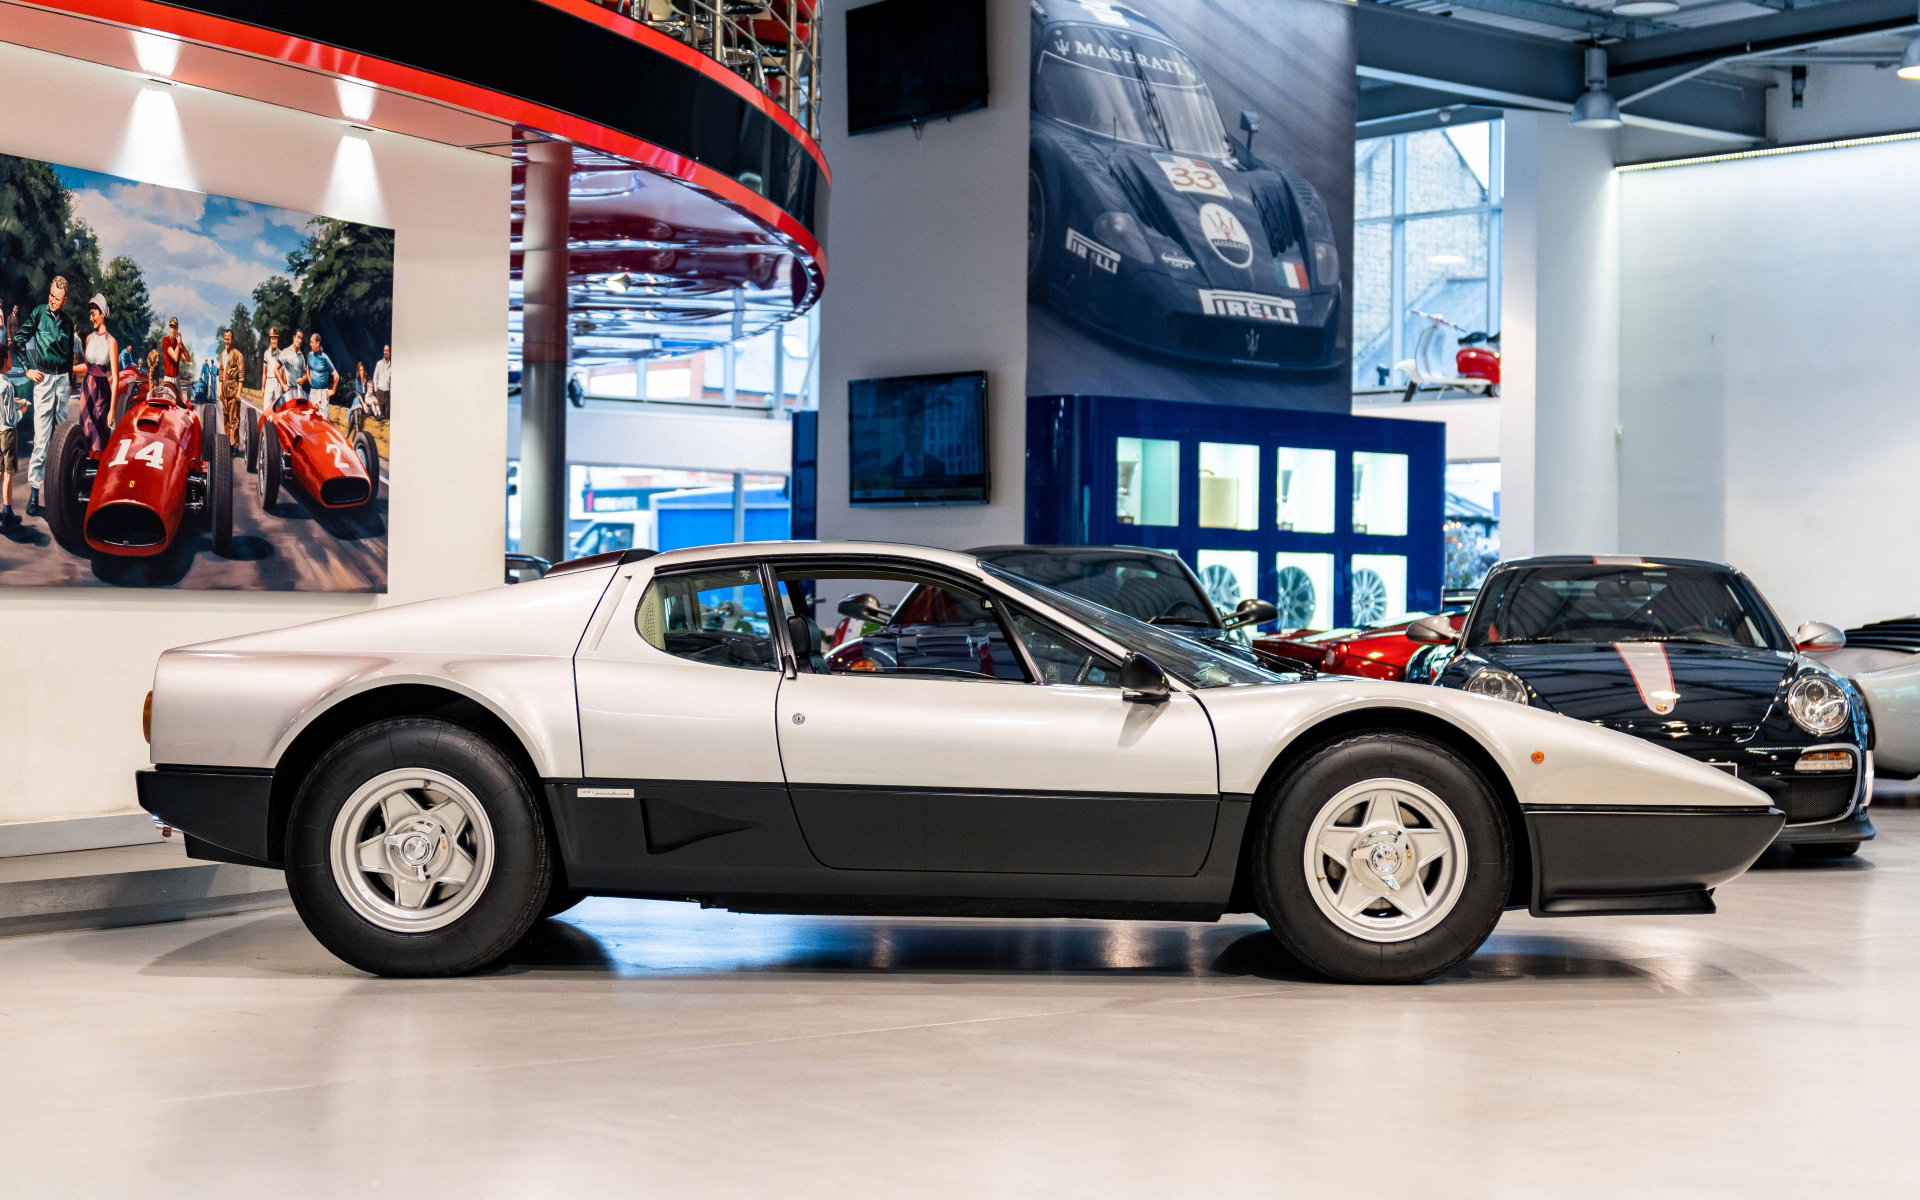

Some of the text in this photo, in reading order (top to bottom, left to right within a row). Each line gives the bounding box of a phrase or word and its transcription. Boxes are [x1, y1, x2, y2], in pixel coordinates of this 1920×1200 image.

[1075, 40, 1184, 76] MASERATI
[1171, 167, 1217, 190] 33
[1198, 288, 1299, 325] PIRELLI
[108, 438, 165, 470] 14
[325, 443, 350, 468] 2
